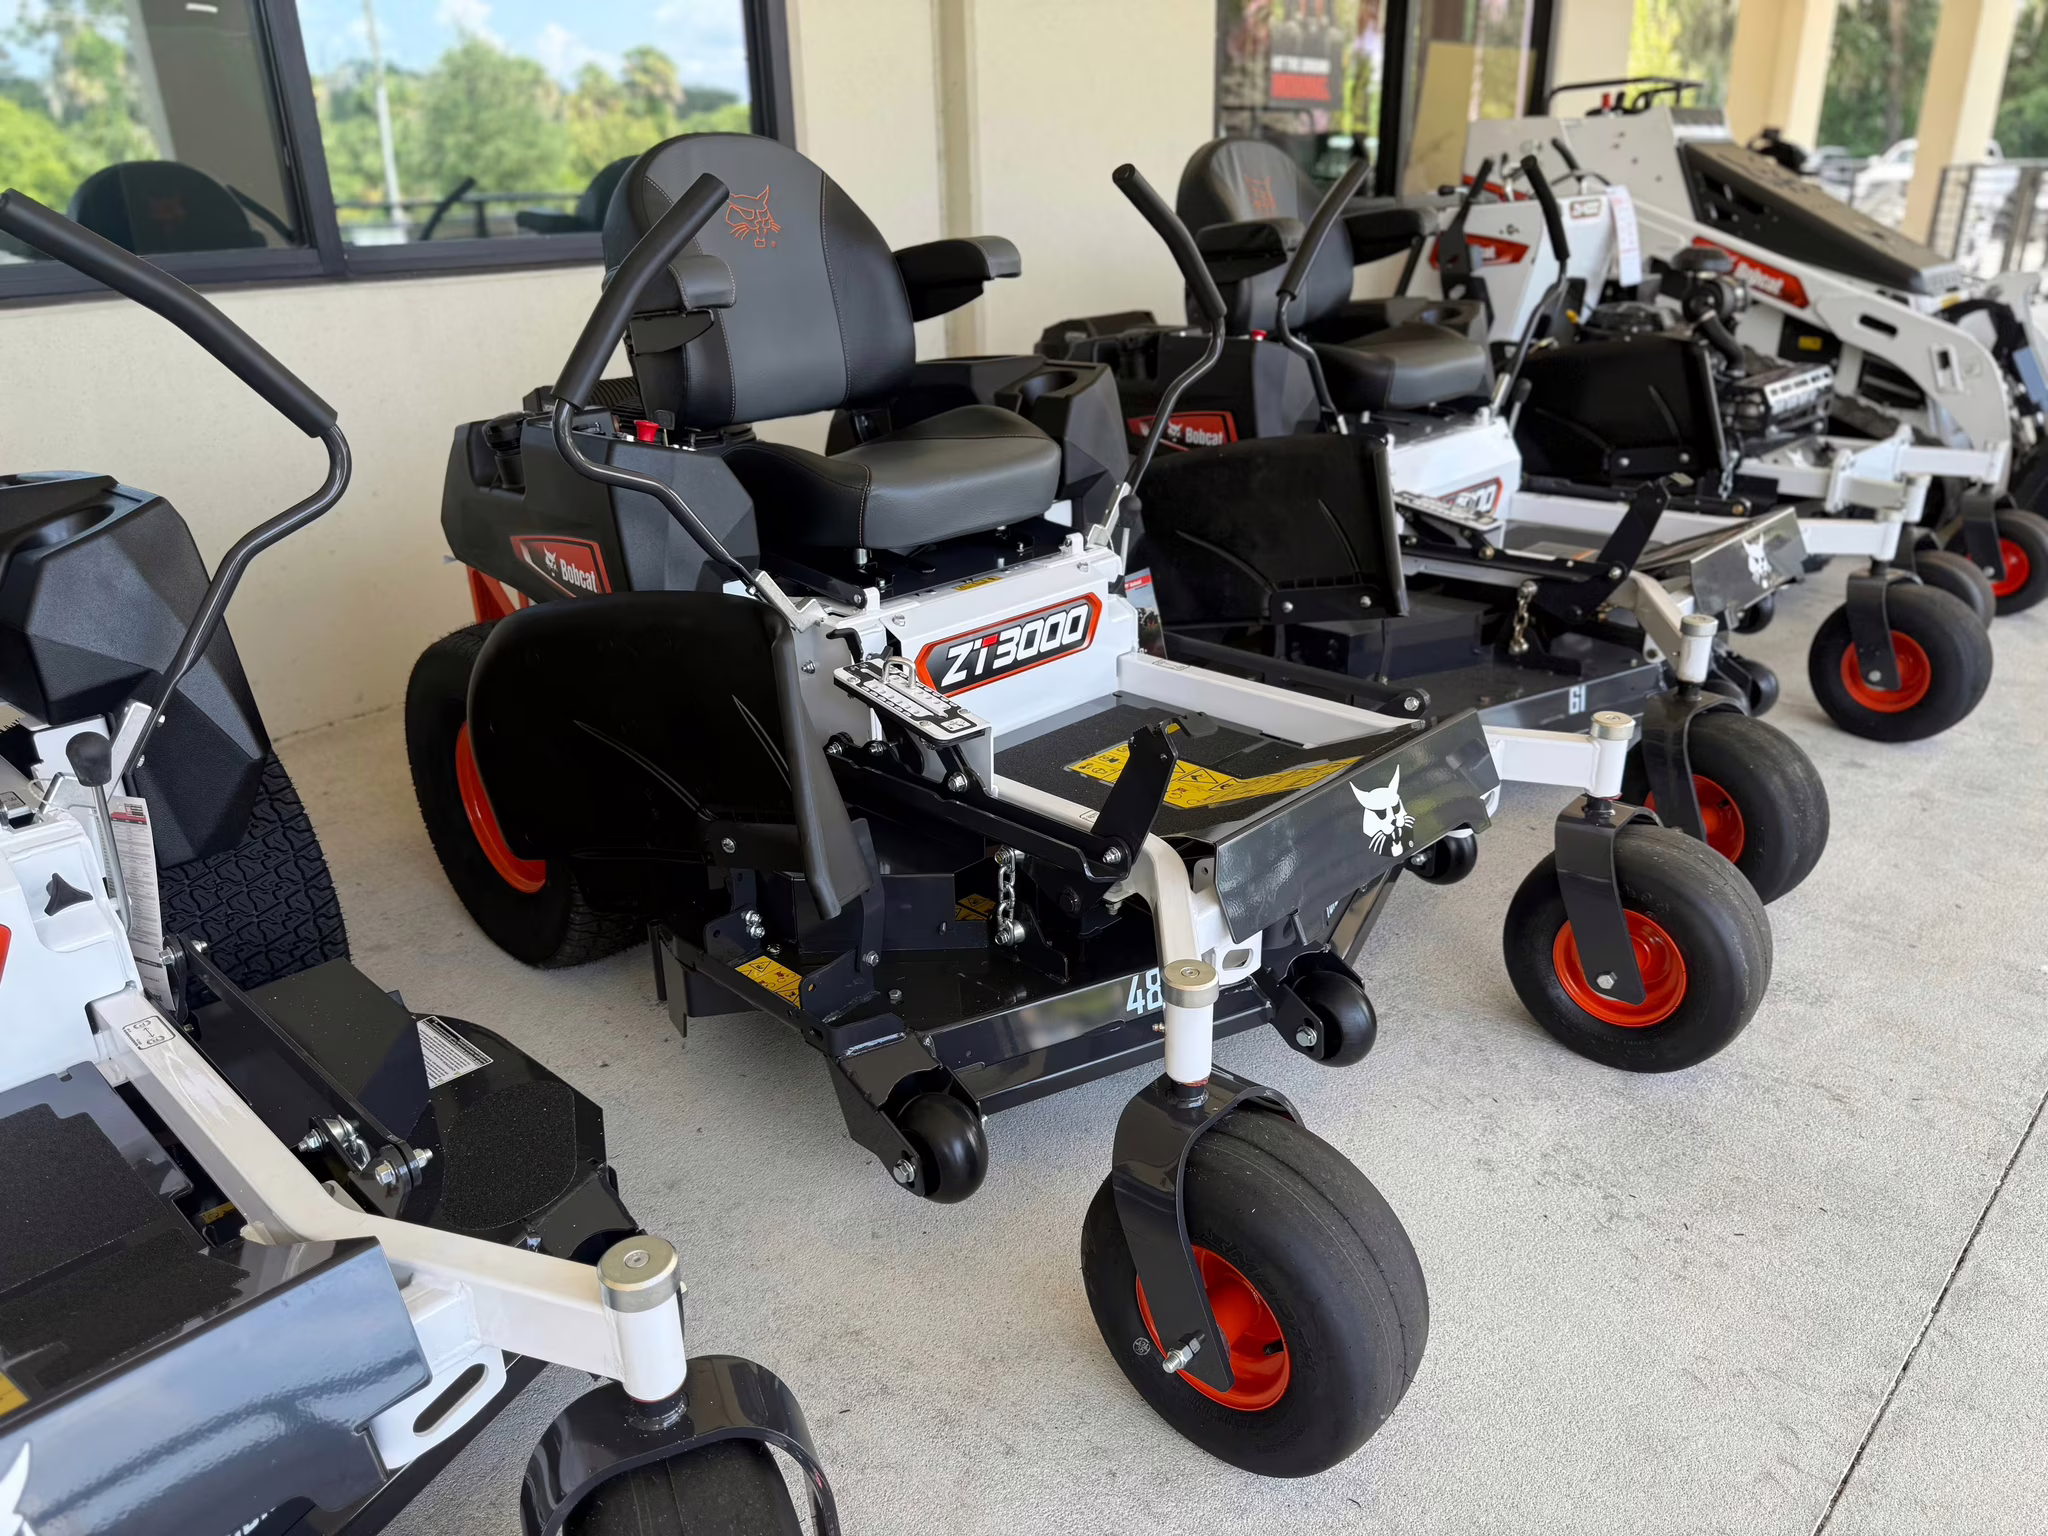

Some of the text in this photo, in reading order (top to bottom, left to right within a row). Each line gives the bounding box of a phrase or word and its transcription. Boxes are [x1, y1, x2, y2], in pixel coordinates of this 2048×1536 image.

[1185, 426, 1224, 446] Bobcat
[559, 557, 598, 594] Bobcat
[940, 602, 1090, 688] ZT3000
[1569, 684, 1586, 715] 61
[1126, 967, 1163, 1015] 48
